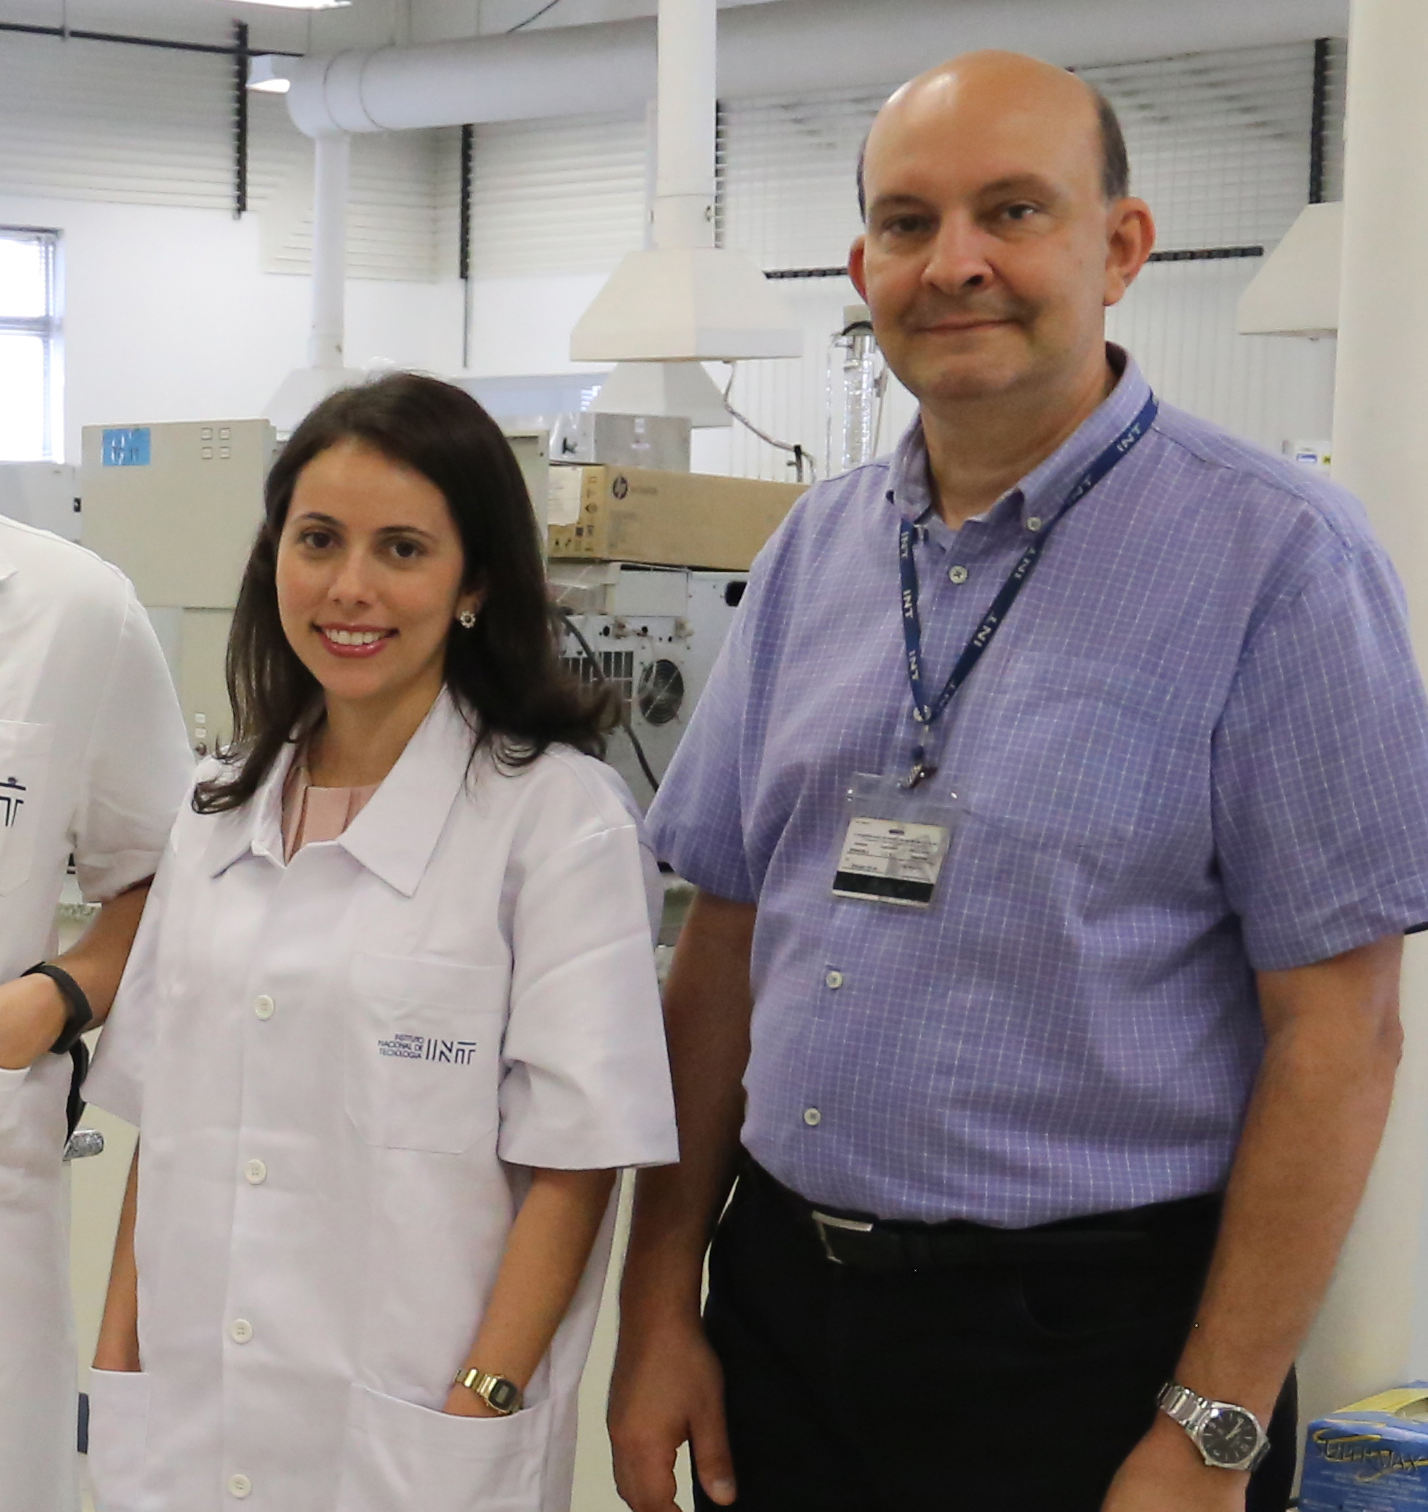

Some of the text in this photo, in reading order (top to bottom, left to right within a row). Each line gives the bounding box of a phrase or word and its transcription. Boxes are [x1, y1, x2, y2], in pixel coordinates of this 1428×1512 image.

[1116, 422, 1142, 453] INT
[900, 531, 910, 559] INT
[1014, 547, 1037, 580] INT
[902, 588, 914, 619] INT
[973, 611, 999, 648] INT
[908, 649, 921, 681] INT
